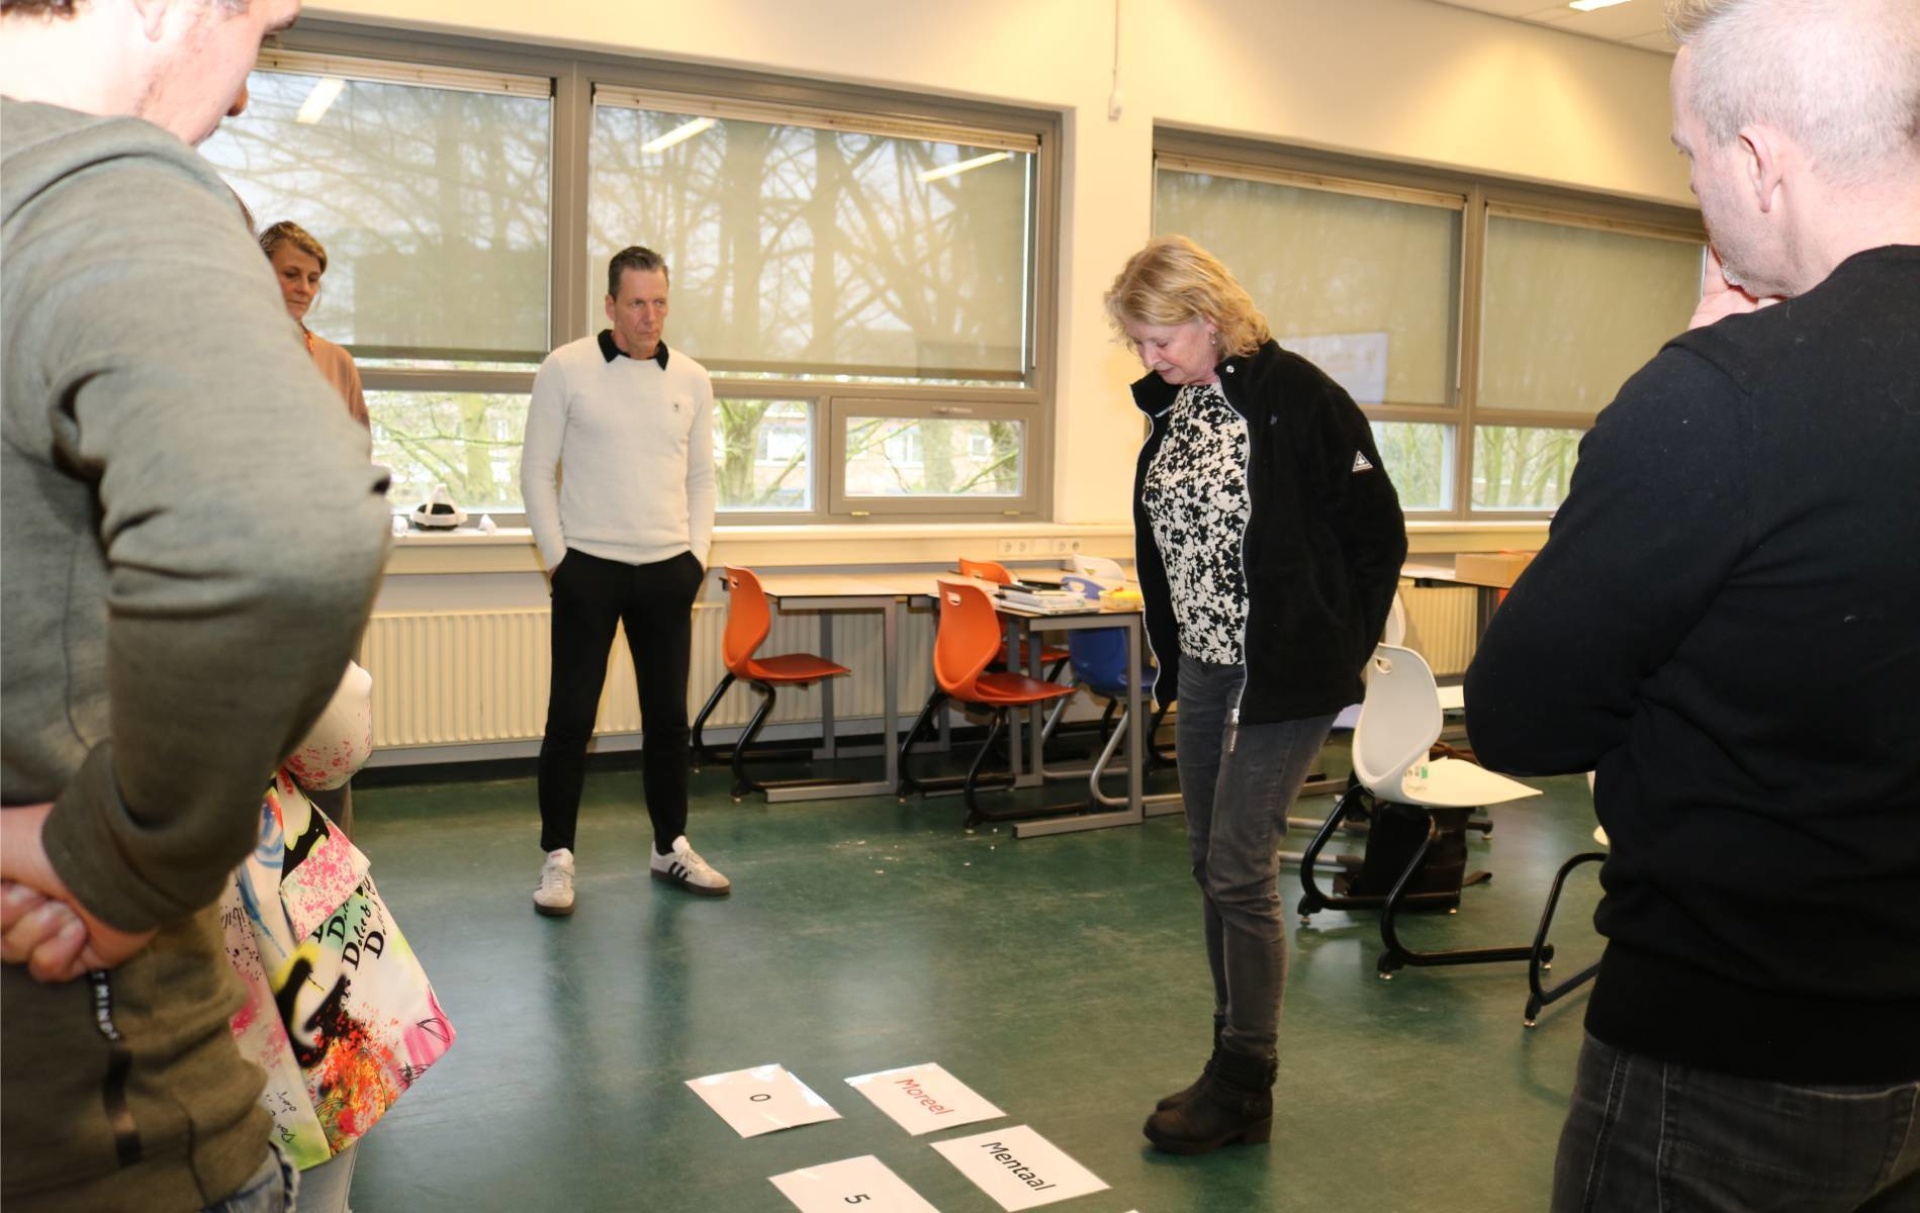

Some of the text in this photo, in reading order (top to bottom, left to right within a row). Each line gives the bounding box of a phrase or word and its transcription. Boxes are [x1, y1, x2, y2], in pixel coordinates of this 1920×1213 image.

[894, 1078, 955, 1115] Moreel
[980, 1142, 1056, 1191] Mentaal
[844, 1193, 871, 1204] 5
